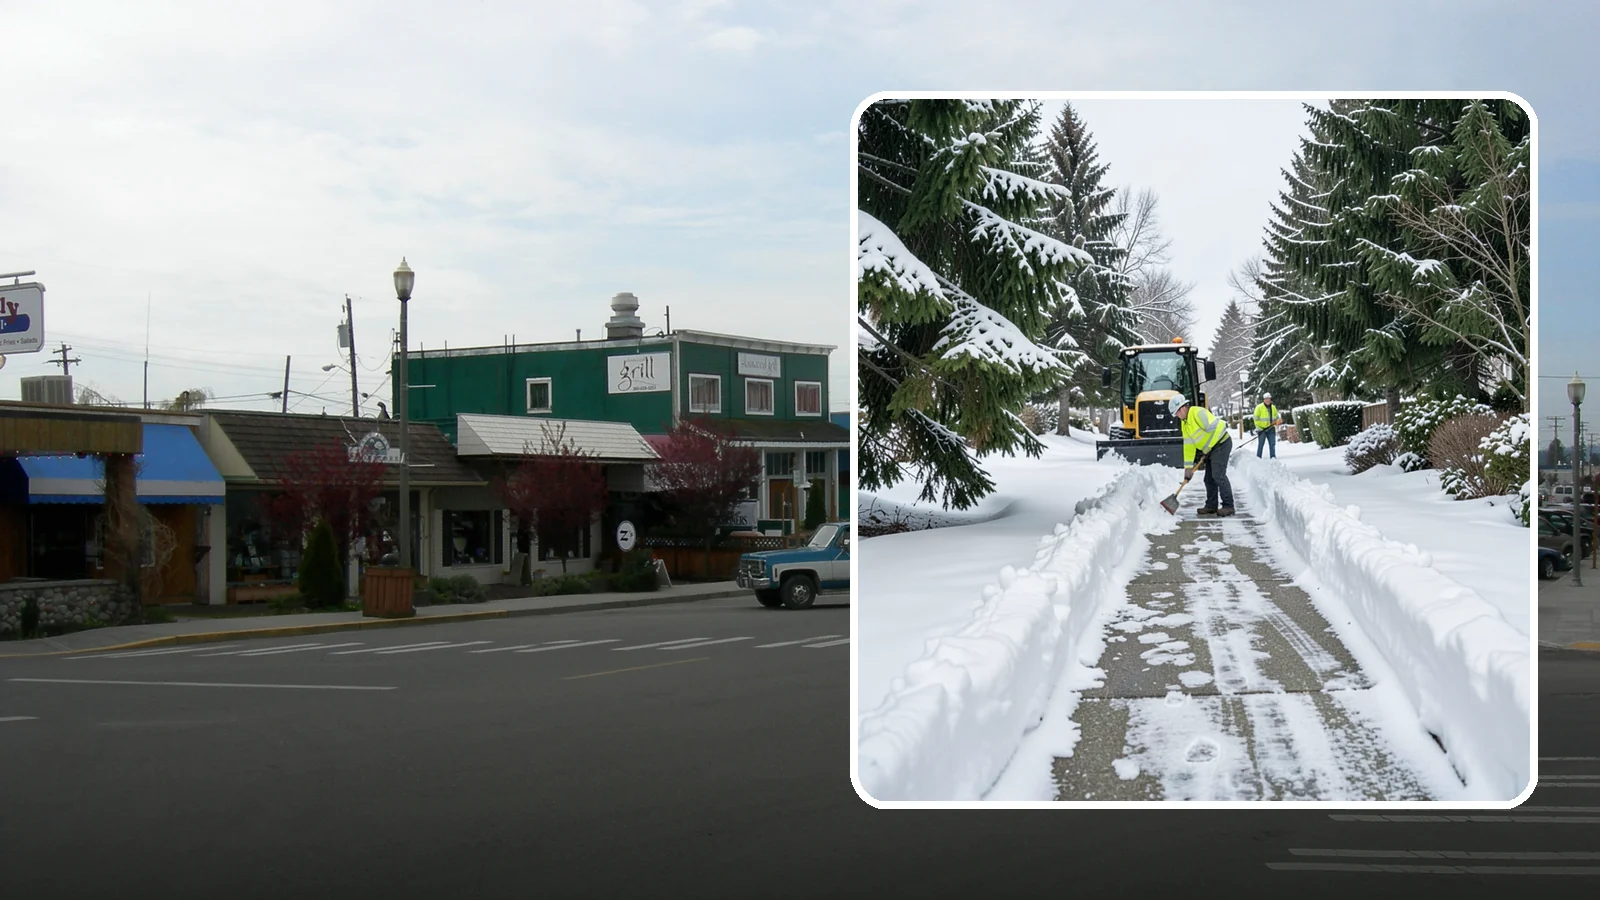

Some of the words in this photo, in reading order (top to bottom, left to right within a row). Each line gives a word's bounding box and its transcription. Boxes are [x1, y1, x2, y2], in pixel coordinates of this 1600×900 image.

[3, 338, 16, 346] Fries
[20, 337, 38, 345] Salads
[617, 355, 655, 391] grill
